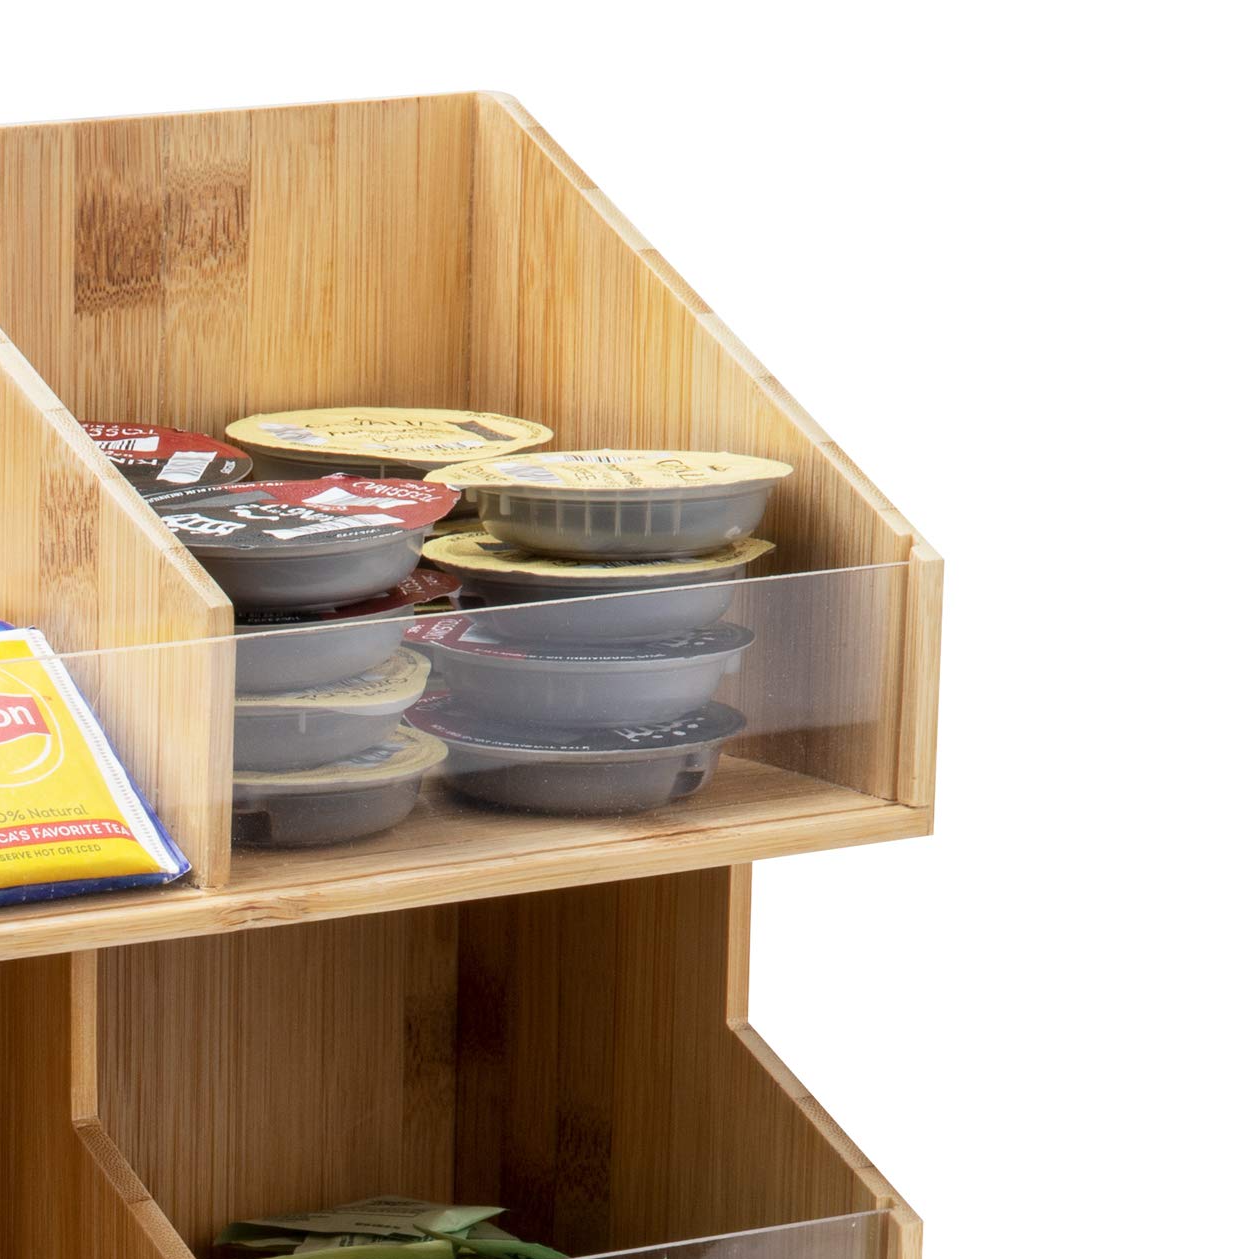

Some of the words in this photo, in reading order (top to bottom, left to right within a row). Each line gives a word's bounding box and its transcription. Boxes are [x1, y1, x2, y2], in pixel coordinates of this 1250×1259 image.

[30, 804, 89, 819] Natural
[32, 821, 104, 841] FAVORITE
[102, 820, 130, 837] TEA
[34, 846, 60, 858] HOT
[59, 845, 74, 856] OR
[75, 842, 102, 855] ICED
